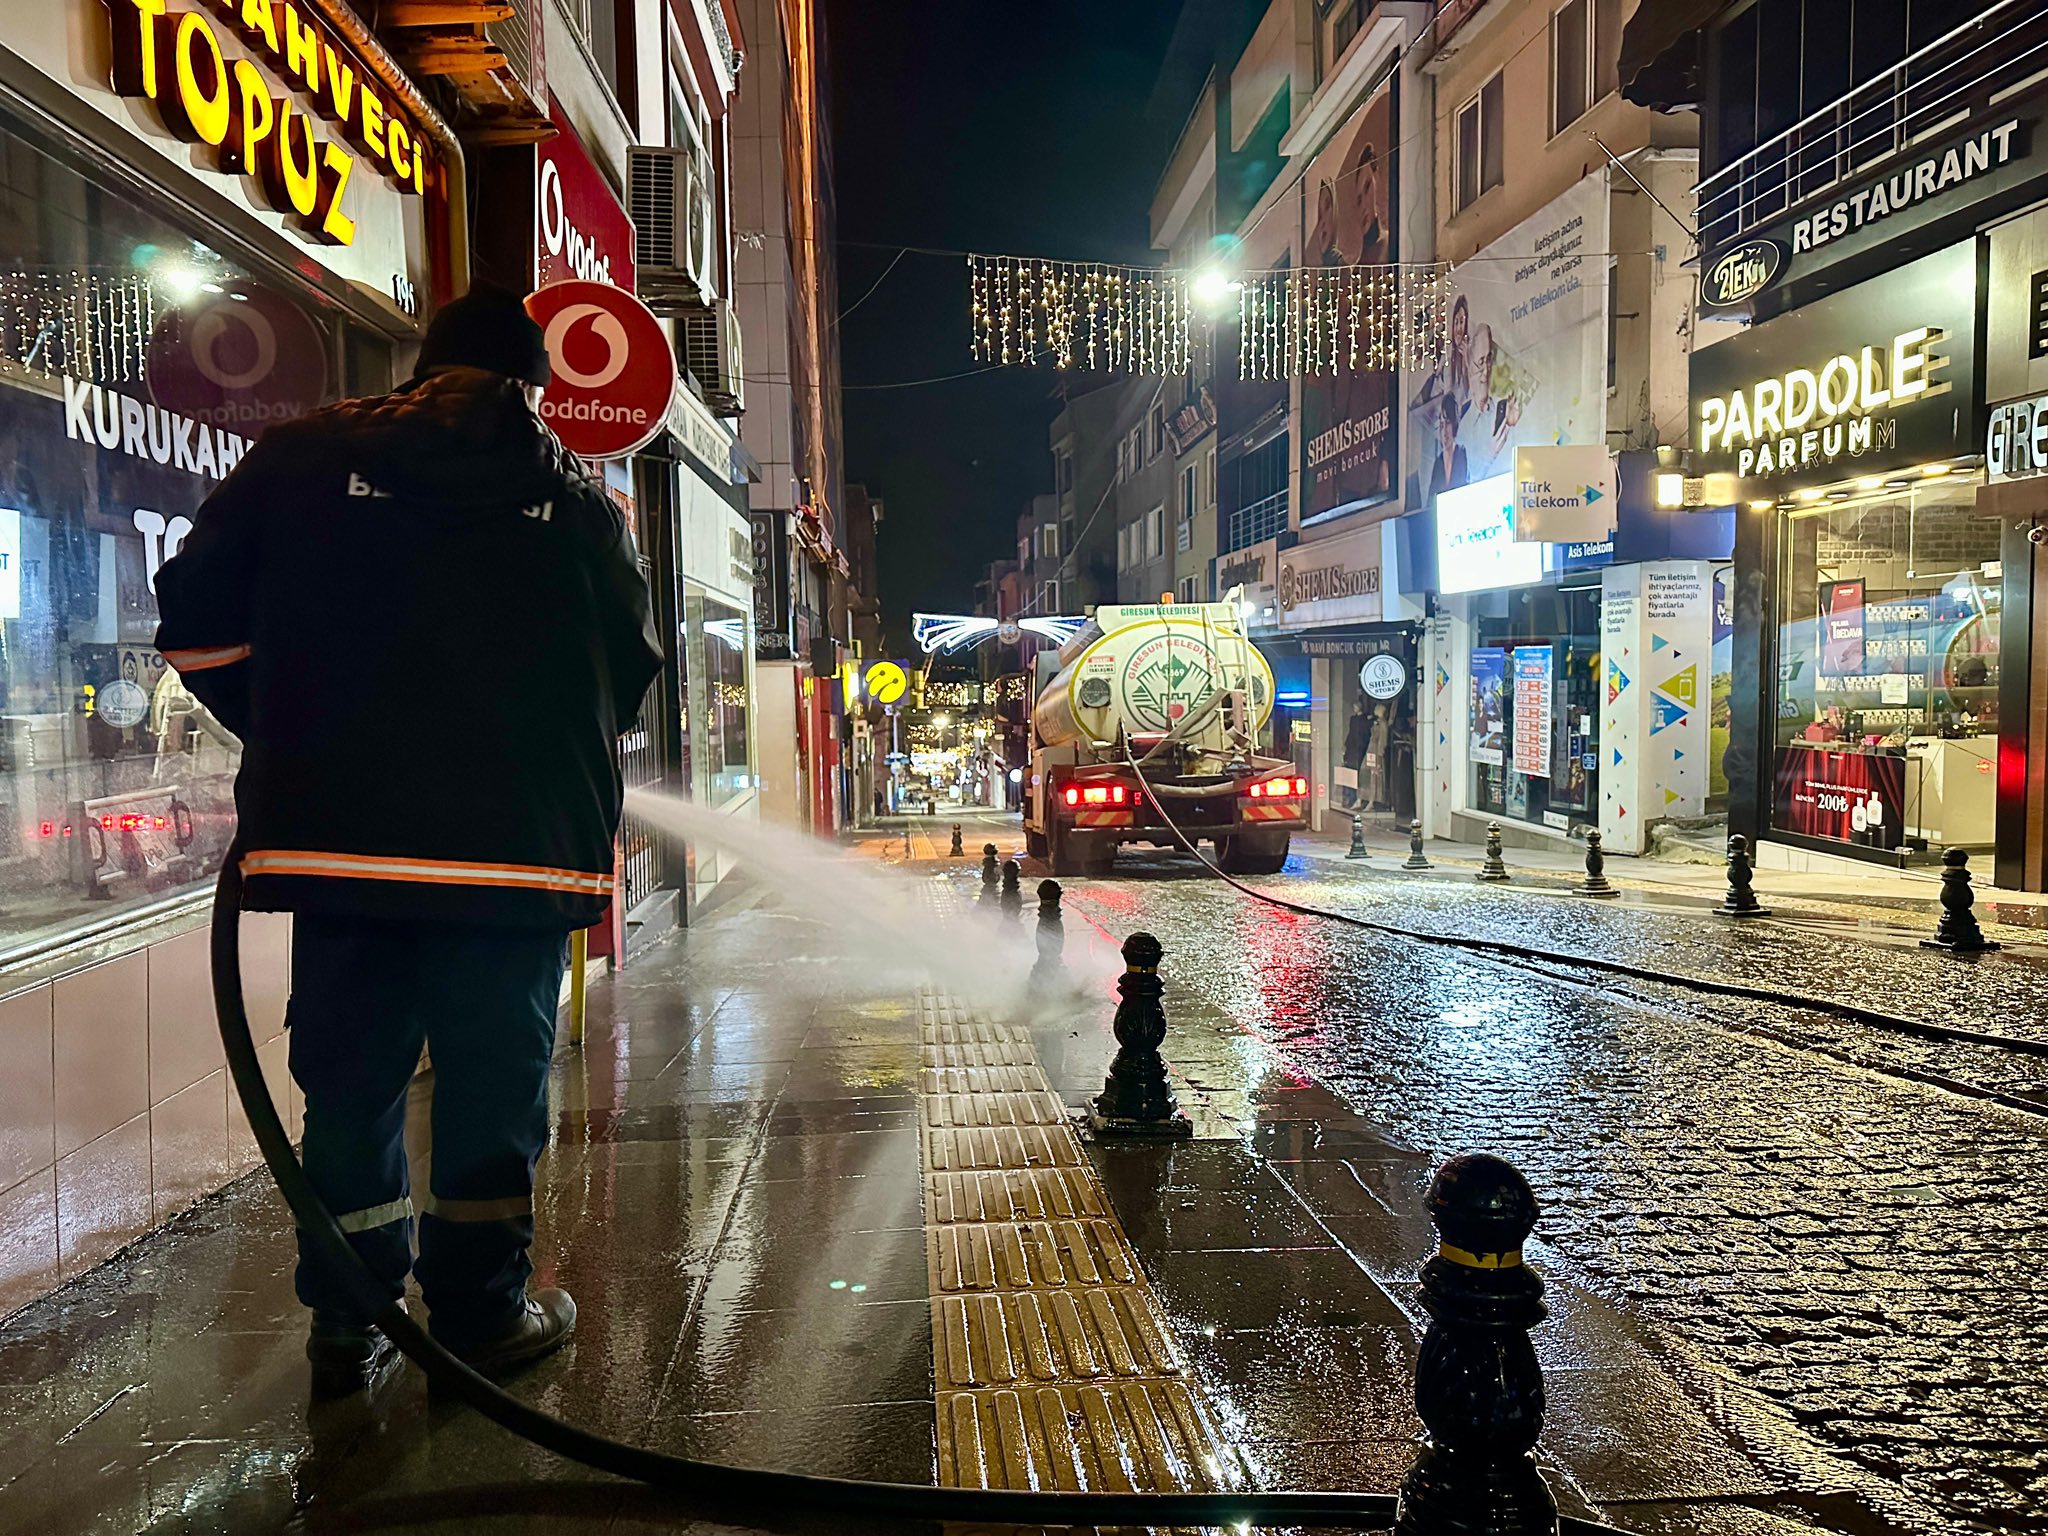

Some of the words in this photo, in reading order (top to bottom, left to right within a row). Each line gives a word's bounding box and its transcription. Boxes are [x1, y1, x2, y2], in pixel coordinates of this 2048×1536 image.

[128, 0, 355, 247] TOPUZ
[1792, 119, 2018, 255] RESTAURANT
[1510, 301, 1528, 323] Türk
[1701, 326, 1929, 454] PARDOLE
[539, 397, 648, 425] odafone
[1307, 417, 1352, 469] SHEMS
[1353, 406, 1389, 446] STORE
[1738, 416, 1872, 479] PARFUM
[1341, 440, 1378, 472] boncuk
[1520, 480, 1552, 494] Türk
[1520, 496, 1580, 509] Telekom
[1568, 546, 1583, 559] Asis
[1583, 540, 1615, 557] Telekom
[1295, 566, 1342, 600] SHEMS
[1342, 567, 1379, 598] STORE
[1649, 573, 1667, 581] Tüm
[1667, 573, 1697, 582] iletişim
[1648, 592, 1662, 600] çok
[1648, 601, 1685, 610] fiyatlarla
[1120, 607, 1155, 617] GİRESUN
[1648, 610, 1676, 618] burada
[1326, 641, 1354, 654] BONCUK
[1128, 640, 1164, 680] GİRESUN
[1368, 677, 1400, 689] SHEMS
